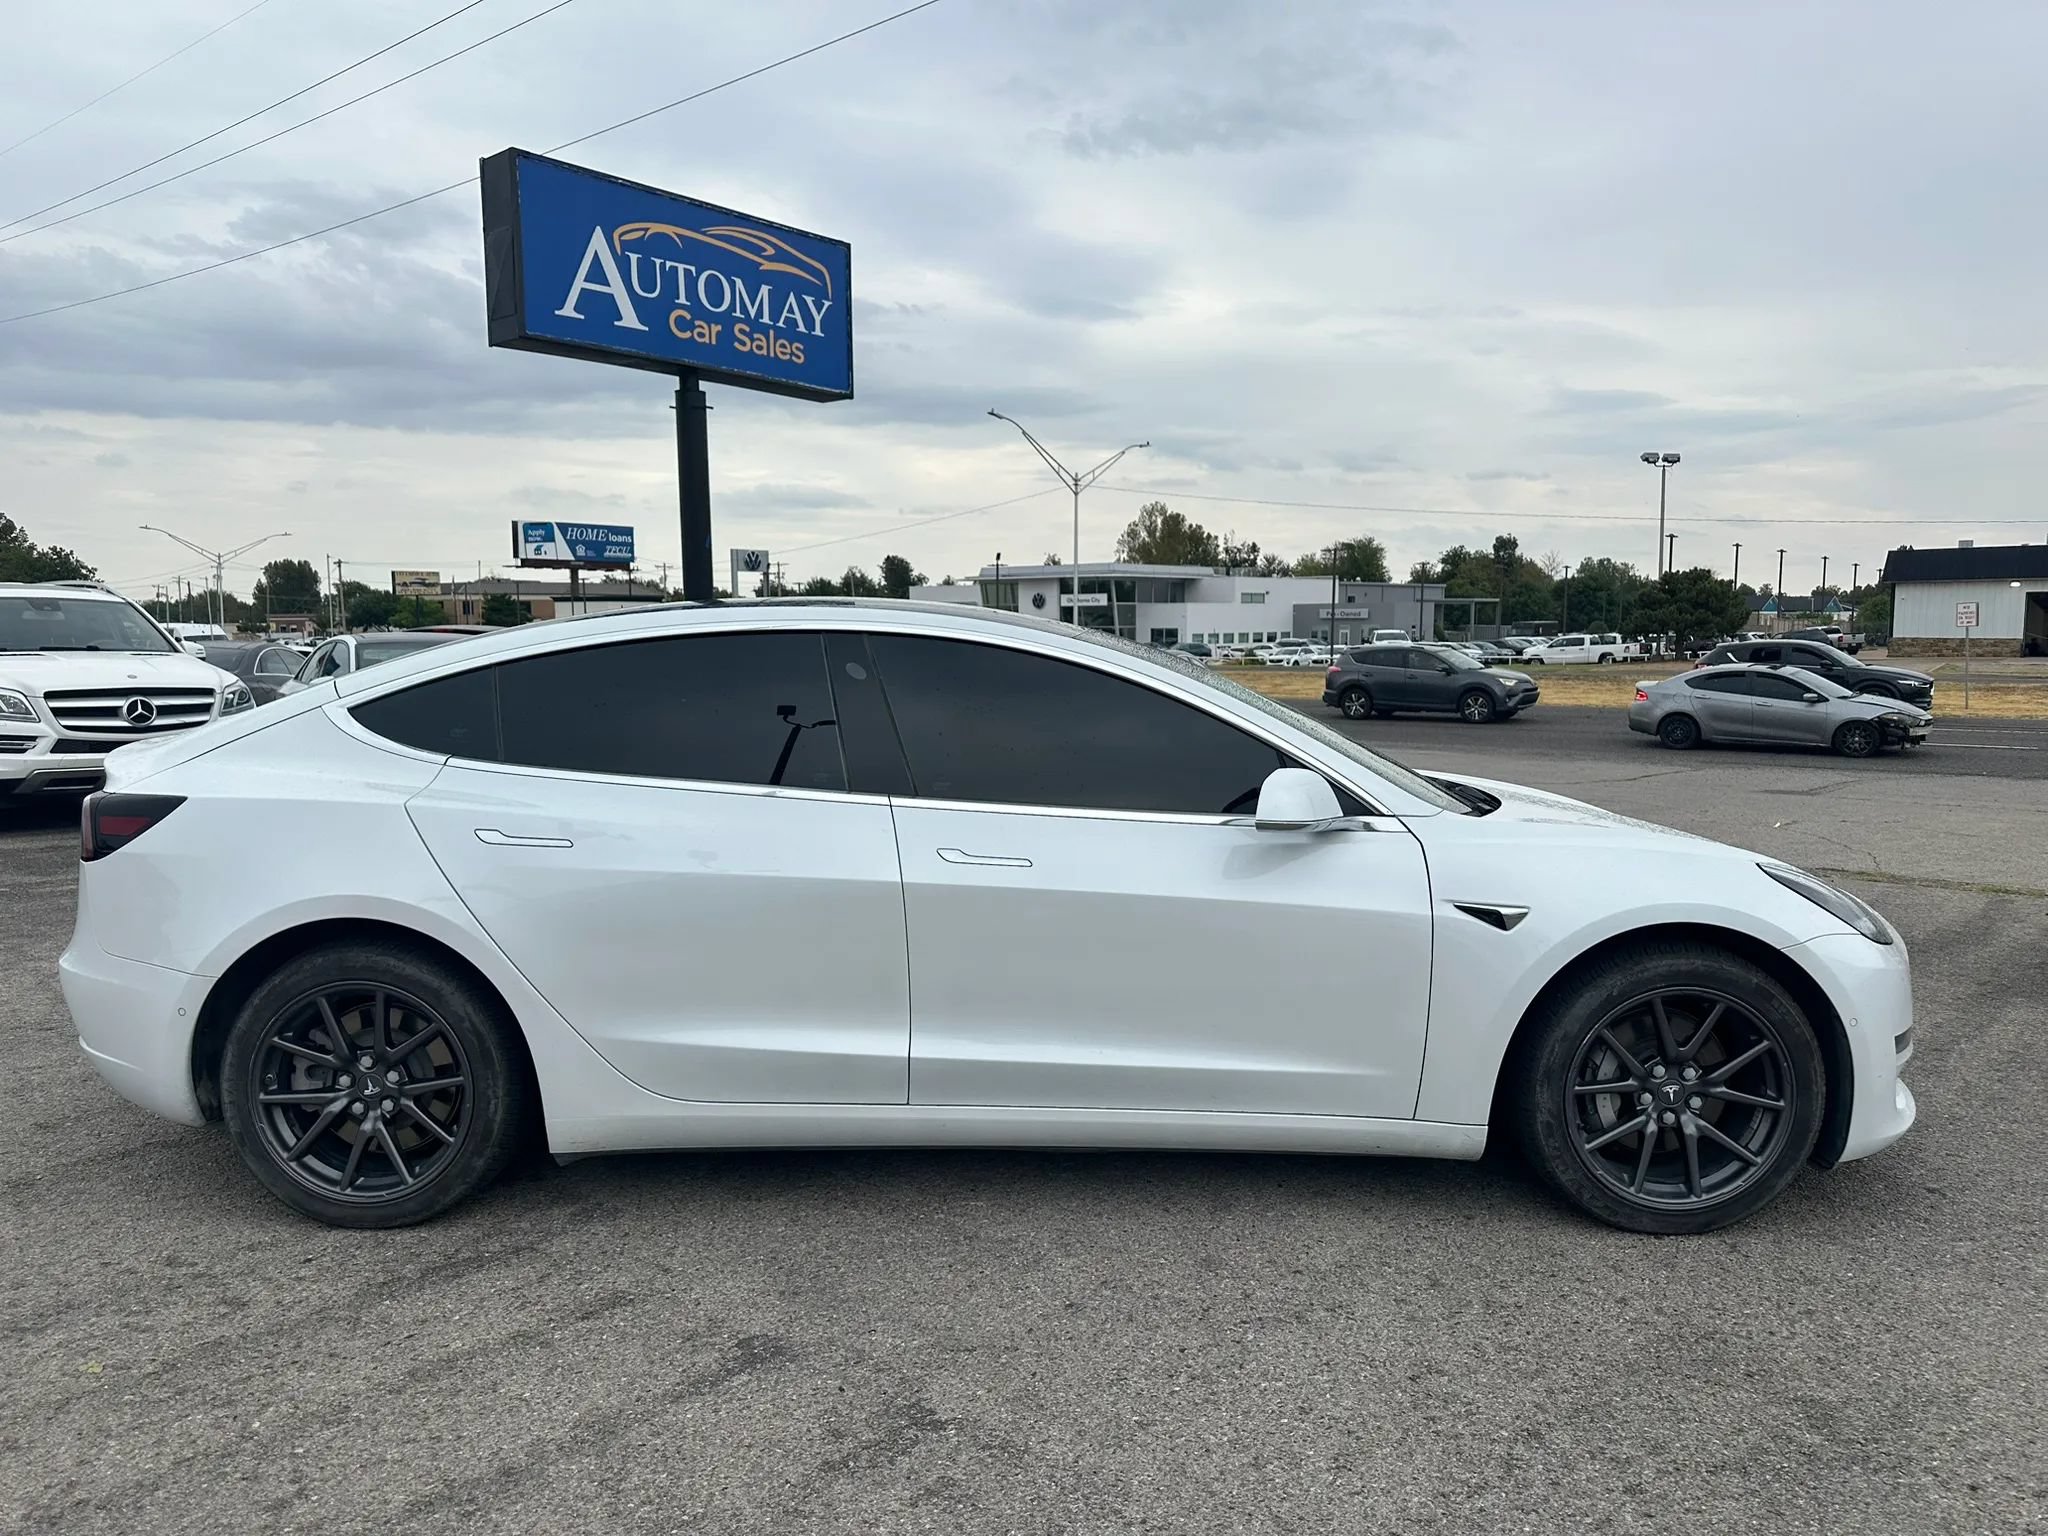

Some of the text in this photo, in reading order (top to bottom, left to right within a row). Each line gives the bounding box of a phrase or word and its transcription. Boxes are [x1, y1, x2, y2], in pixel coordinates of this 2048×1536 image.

[554, 225, 832, 338] AUTOMAY
[668, 309, 805, 364] Car Sales
[527, 529, 545, 537] Apply
[566, 527, 632, 543] HOME loans
